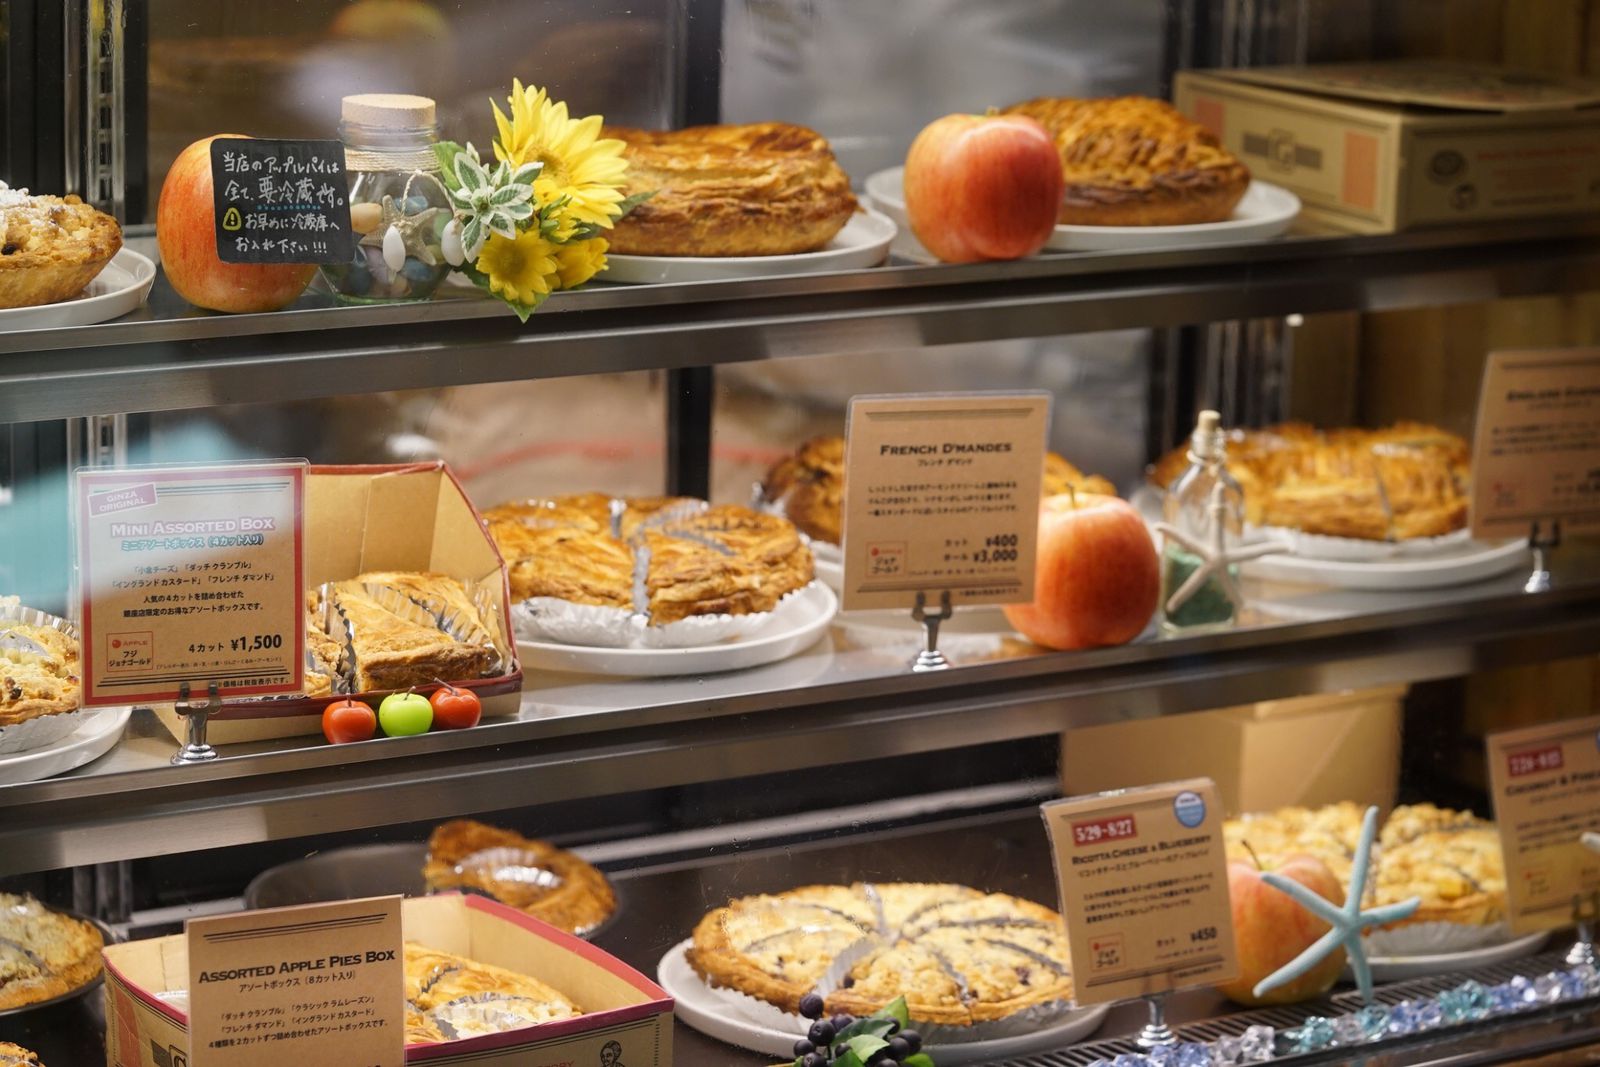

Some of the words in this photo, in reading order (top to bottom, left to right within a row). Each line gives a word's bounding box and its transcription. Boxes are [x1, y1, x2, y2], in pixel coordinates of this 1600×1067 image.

[223, 151, 340, 174] 当店のアップルパイは
[245, 212, 340, 231] お早めに冷蔵庫へ
[880, 444, 937, 456] FRENCH
[943, 442, 1012, 454] D'MANDES
[107, 490, 138, 502] GINZA
[99, 497, 147, 512] ORIGINAL
[111, 523, 148, 537] MINI
[153, 520, 236, 535] ASSORTED
[241, 518, 275, 531] BOX
[986, 534, 1018, 548] ¥400
[973, 549, 1018, 564] ¥3,000
[189, 642, 225, 654] 4カット
[231, 634, 282, 652] ¥1,500
[123, 650, 137, 658] フジ
[199, 965, 275, 984] ASSORTED
[279, 958, 326, 975] APPLE
[330, 955, 362, 968] PIES
[366, 950, 395, 963] BOX
